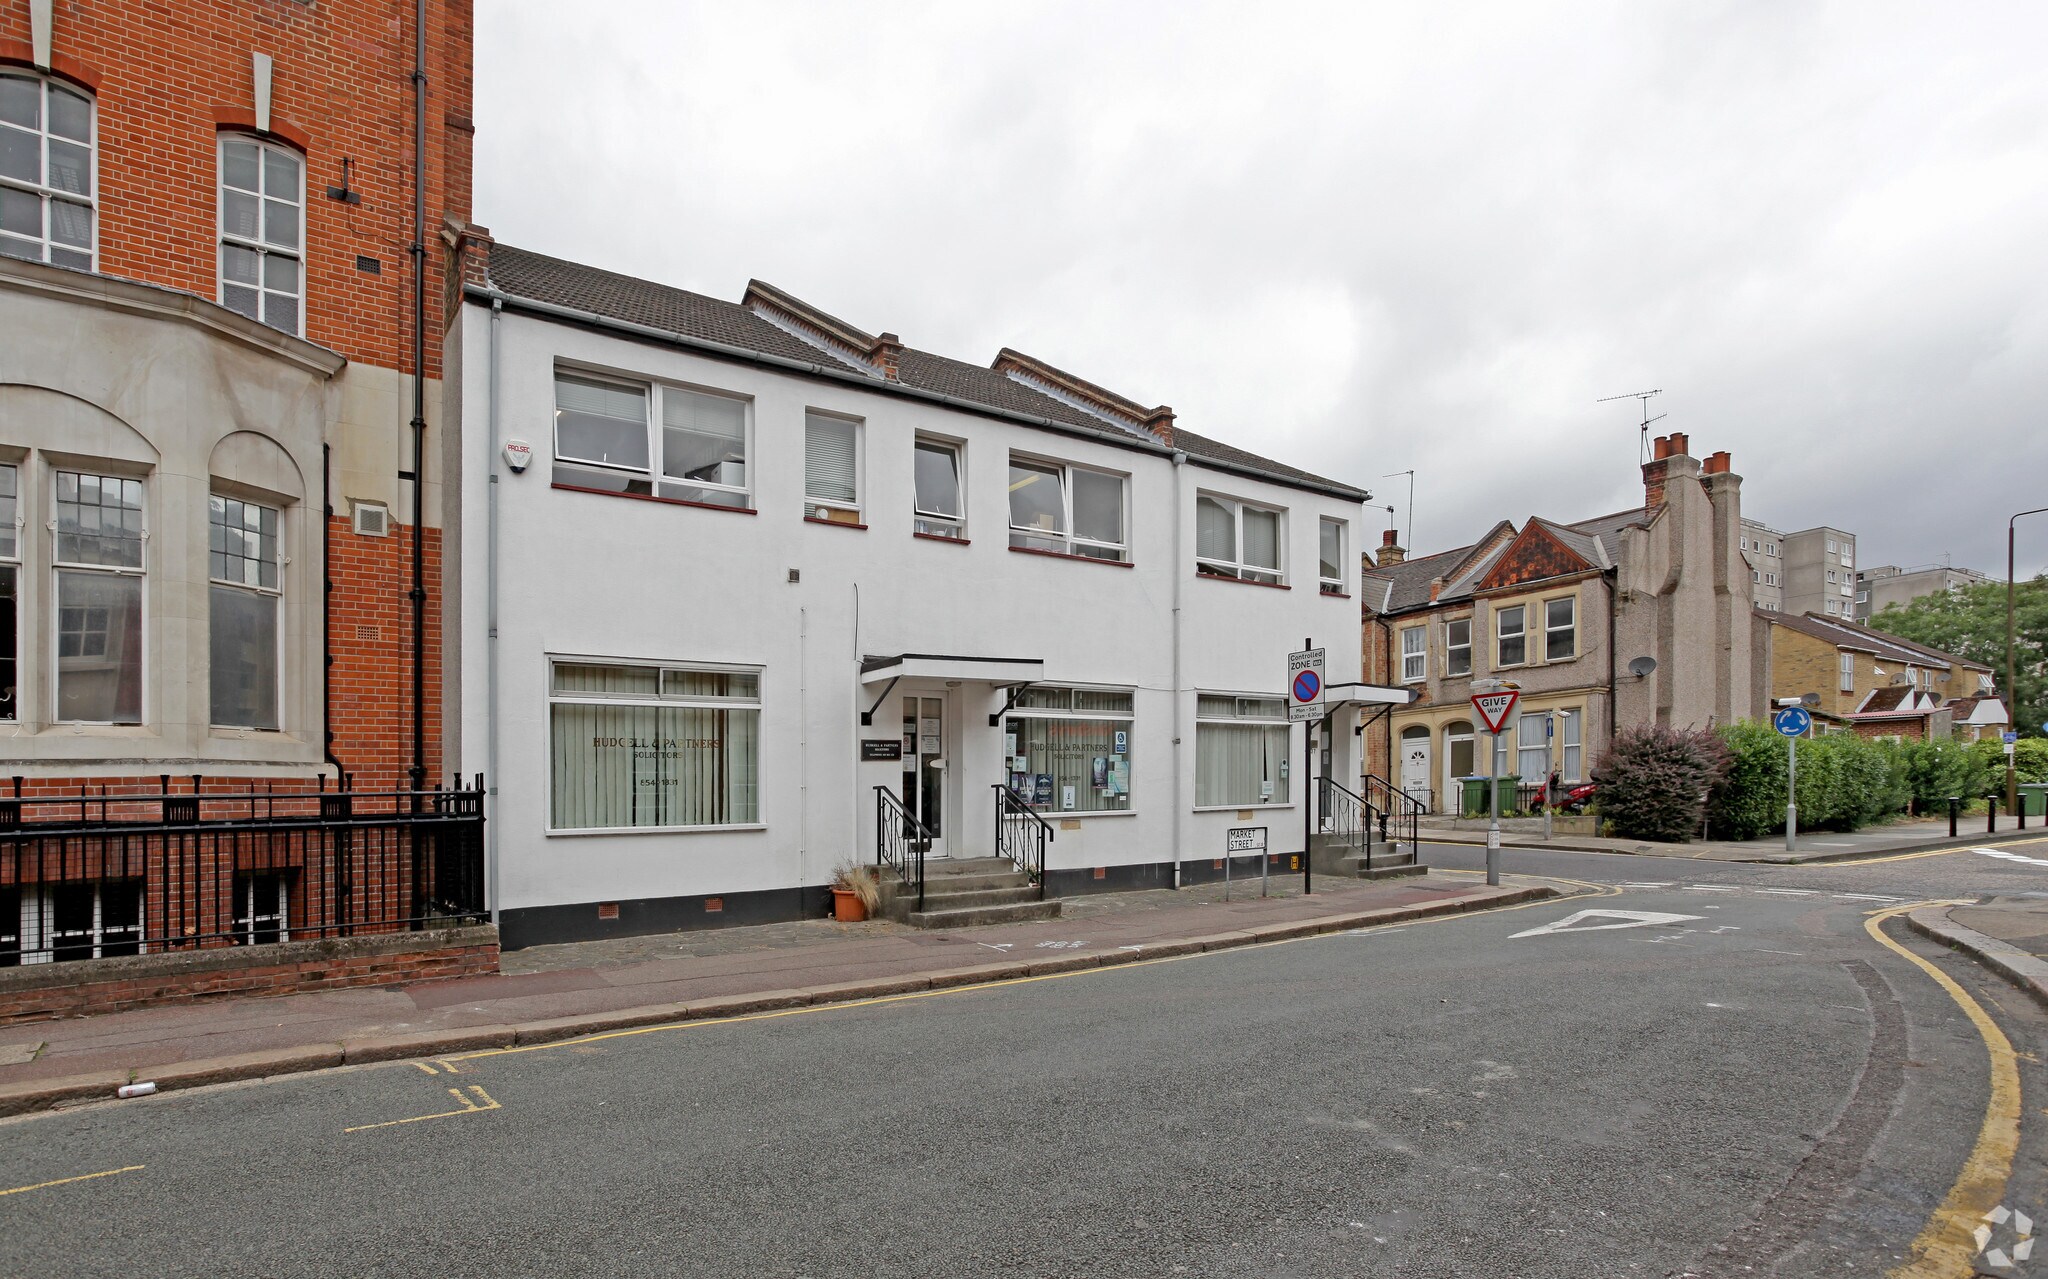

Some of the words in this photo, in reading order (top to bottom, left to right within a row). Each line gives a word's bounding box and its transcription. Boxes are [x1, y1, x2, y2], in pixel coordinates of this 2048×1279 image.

[1290, 650, 1322, 661] Controlled
[1290, 660, 1310, 670] ZONE
[1482, 696, 1506, 706] GIVE
[652, 739, 660, 748] &
[664, 738, 720, 748] PARTNERS
[1030, 743, 1063, 752] HUDGELL
[1072, 744, 1108, 752] PARTNERS
[634, 752, 683, 760] SOLICTORS
[1230, 830, 1255, 839] MARKET
[1230, 840, 1253, 849] STREET
